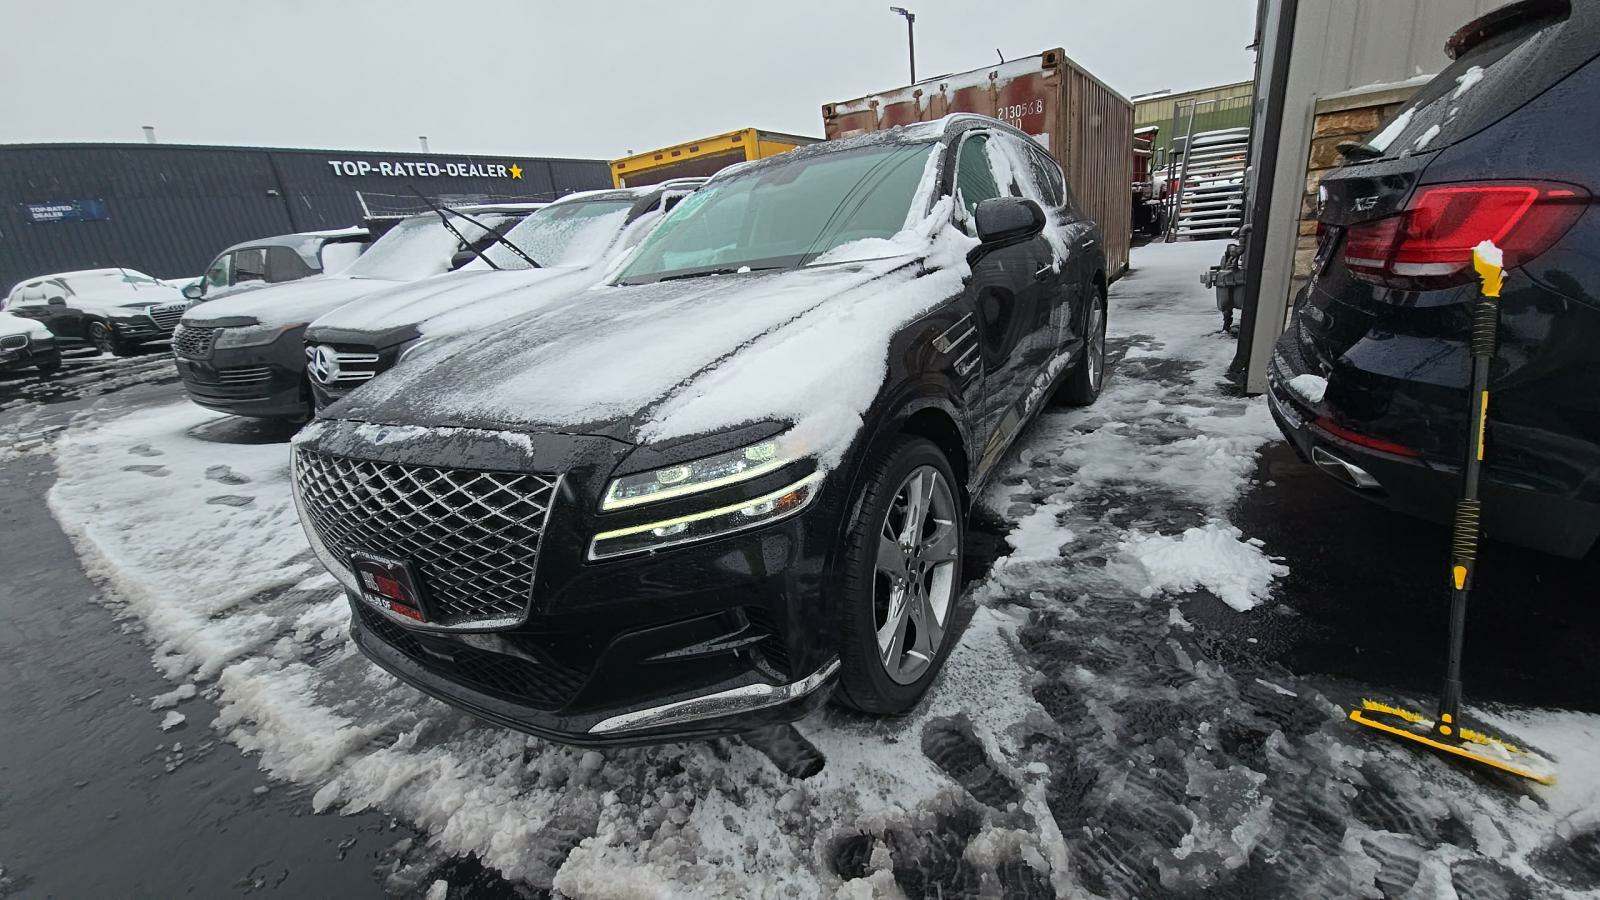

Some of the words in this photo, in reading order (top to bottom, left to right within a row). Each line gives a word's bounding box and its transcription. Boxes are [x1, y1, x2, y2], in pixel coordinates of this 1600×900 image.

[328, 160, 508, 177] TOP-RATED-DEALER
[30, 205, 72, 213] TOP-RATED
[1350, 195, 1379, 211] X5
[33, 211, 63, 219] DEALER
